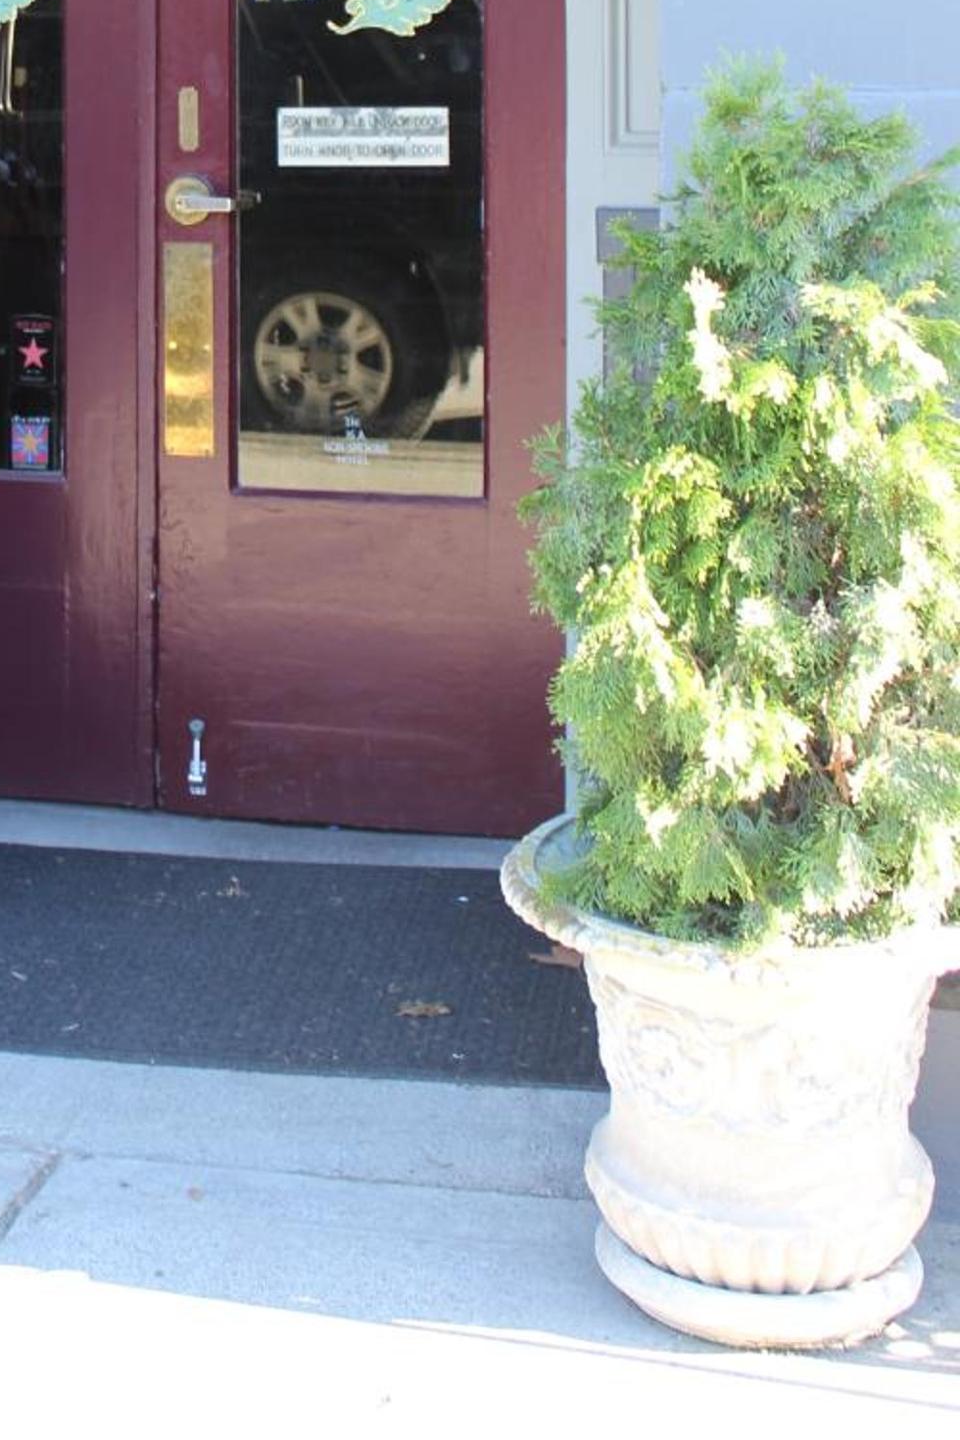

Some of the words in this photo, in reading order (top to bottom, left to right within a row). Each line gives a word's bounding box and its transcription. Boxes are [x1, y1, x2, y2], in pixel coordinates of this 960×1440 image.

[284, 143, 315, 158] TURN
[356, 143, 371, 158] TO
[411, 143, 443, 158] DOOR
